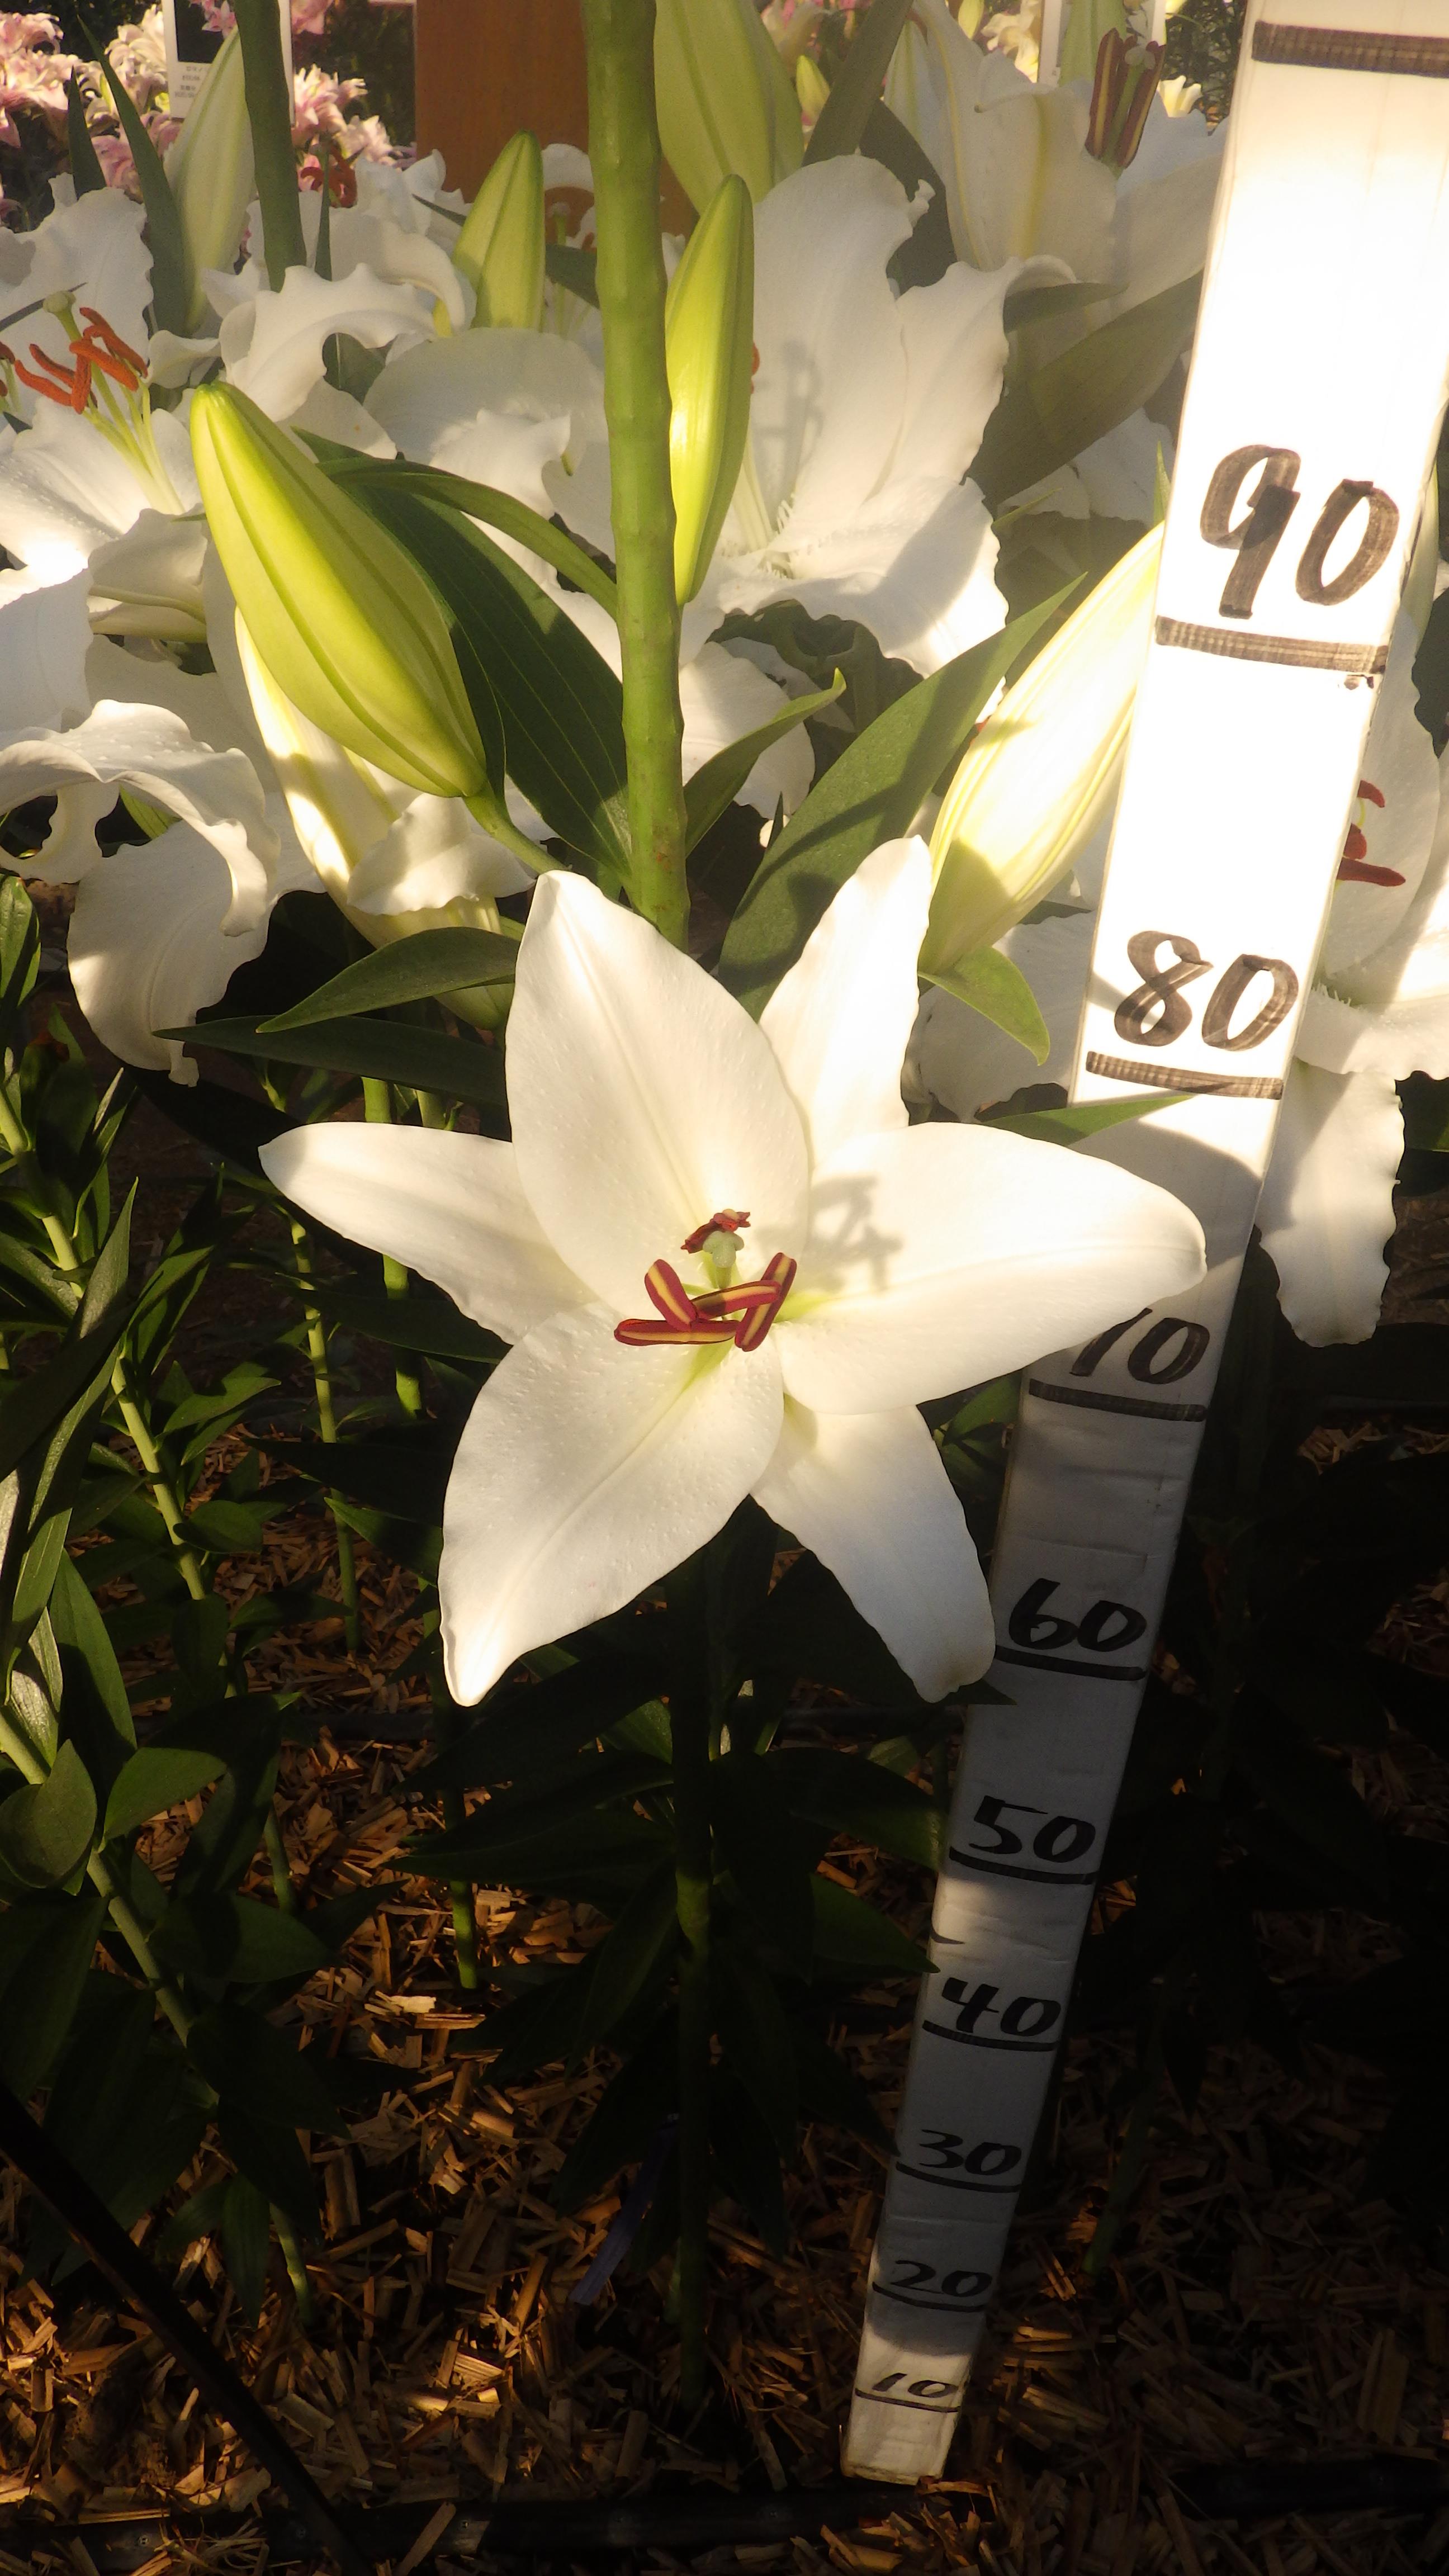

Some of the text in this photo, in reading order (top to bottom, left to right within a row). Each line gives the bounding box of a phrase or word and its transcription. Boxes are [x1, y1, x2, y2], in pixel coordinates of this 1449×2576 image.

[1200, 444, 1399, 619] 90
[1114, 930, 1299, 1052] 80
[1008, 1578, 1147, 1652] 60
[969, 1795, 1096, 1863] 50
[941, 1977, 1061, 2037] 40
[918, 2129, 1022, 2175] 30
[890, 2260, 993, 2297] 20
[872, 2373, 959, 2398] 10
